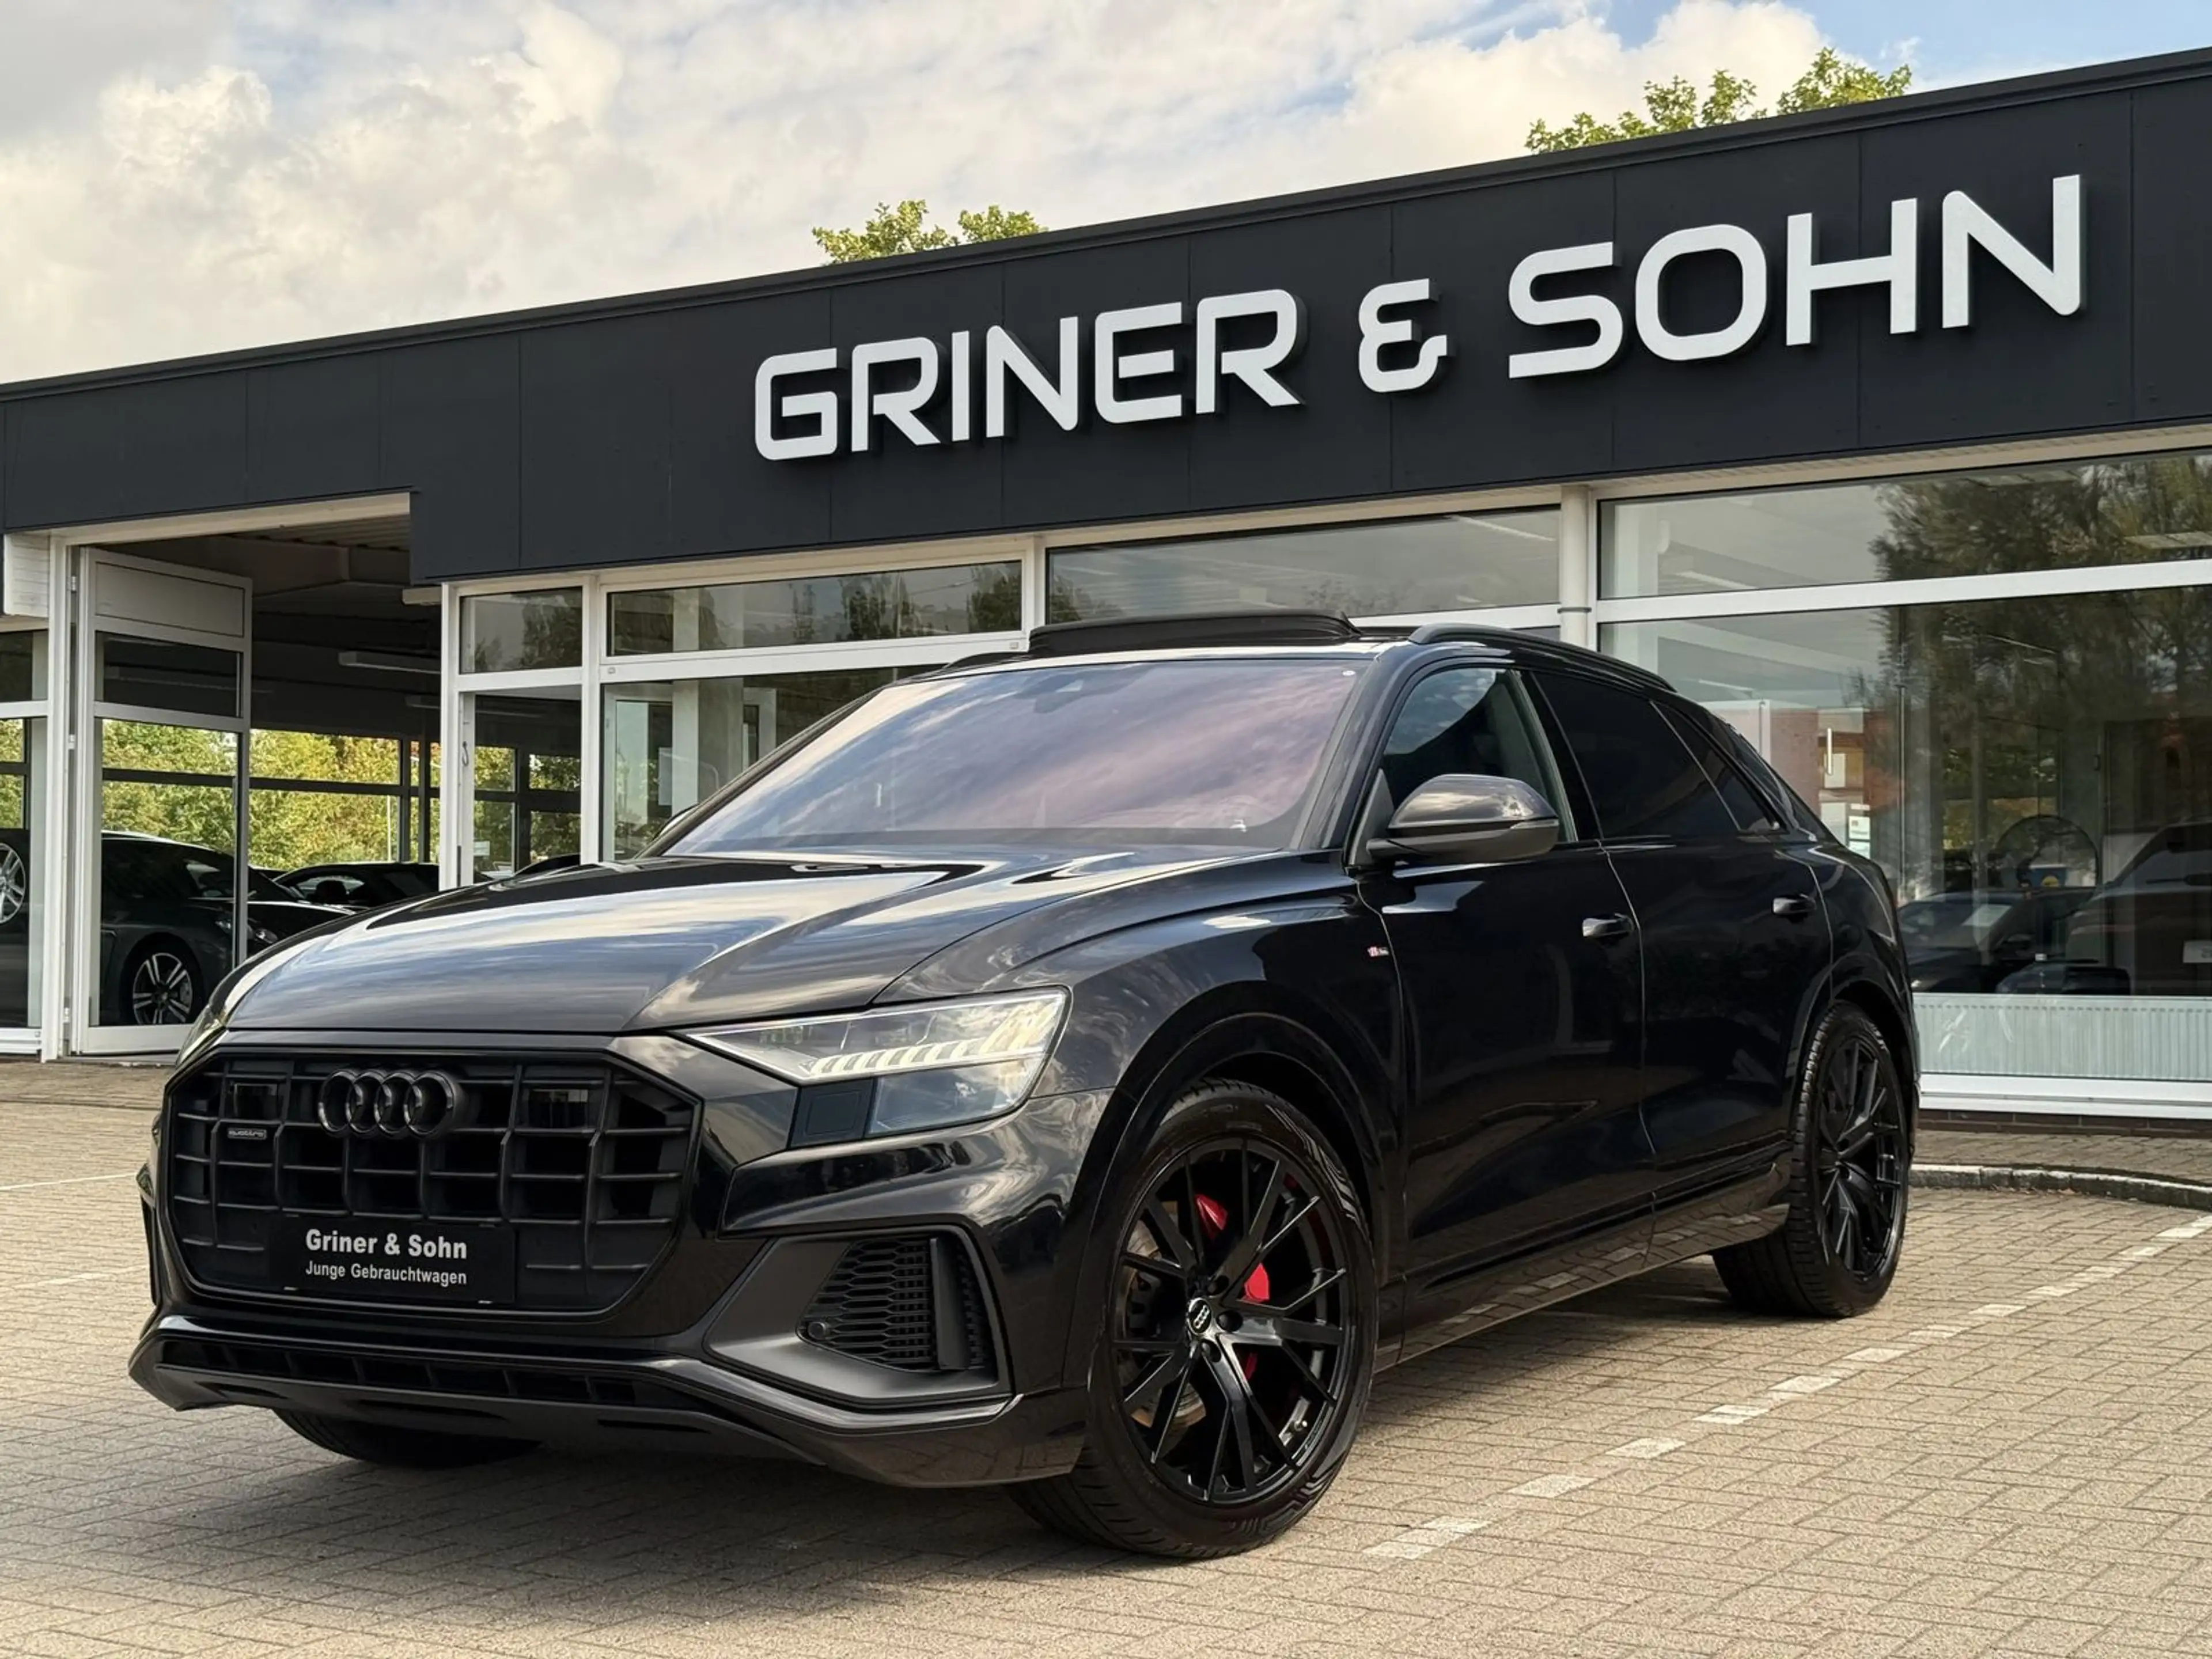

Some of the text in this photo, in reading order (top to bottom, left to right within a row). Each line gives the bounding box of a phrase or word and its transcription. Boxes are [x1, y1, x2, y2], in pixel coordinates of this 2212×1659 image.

[755, 174, 2081, 460] GRINER & SOHN
[306, 1229, 467, 1259] Griner & Sohn
[305, 1260, 467, 1287] Junge Gebrauchtwagen
